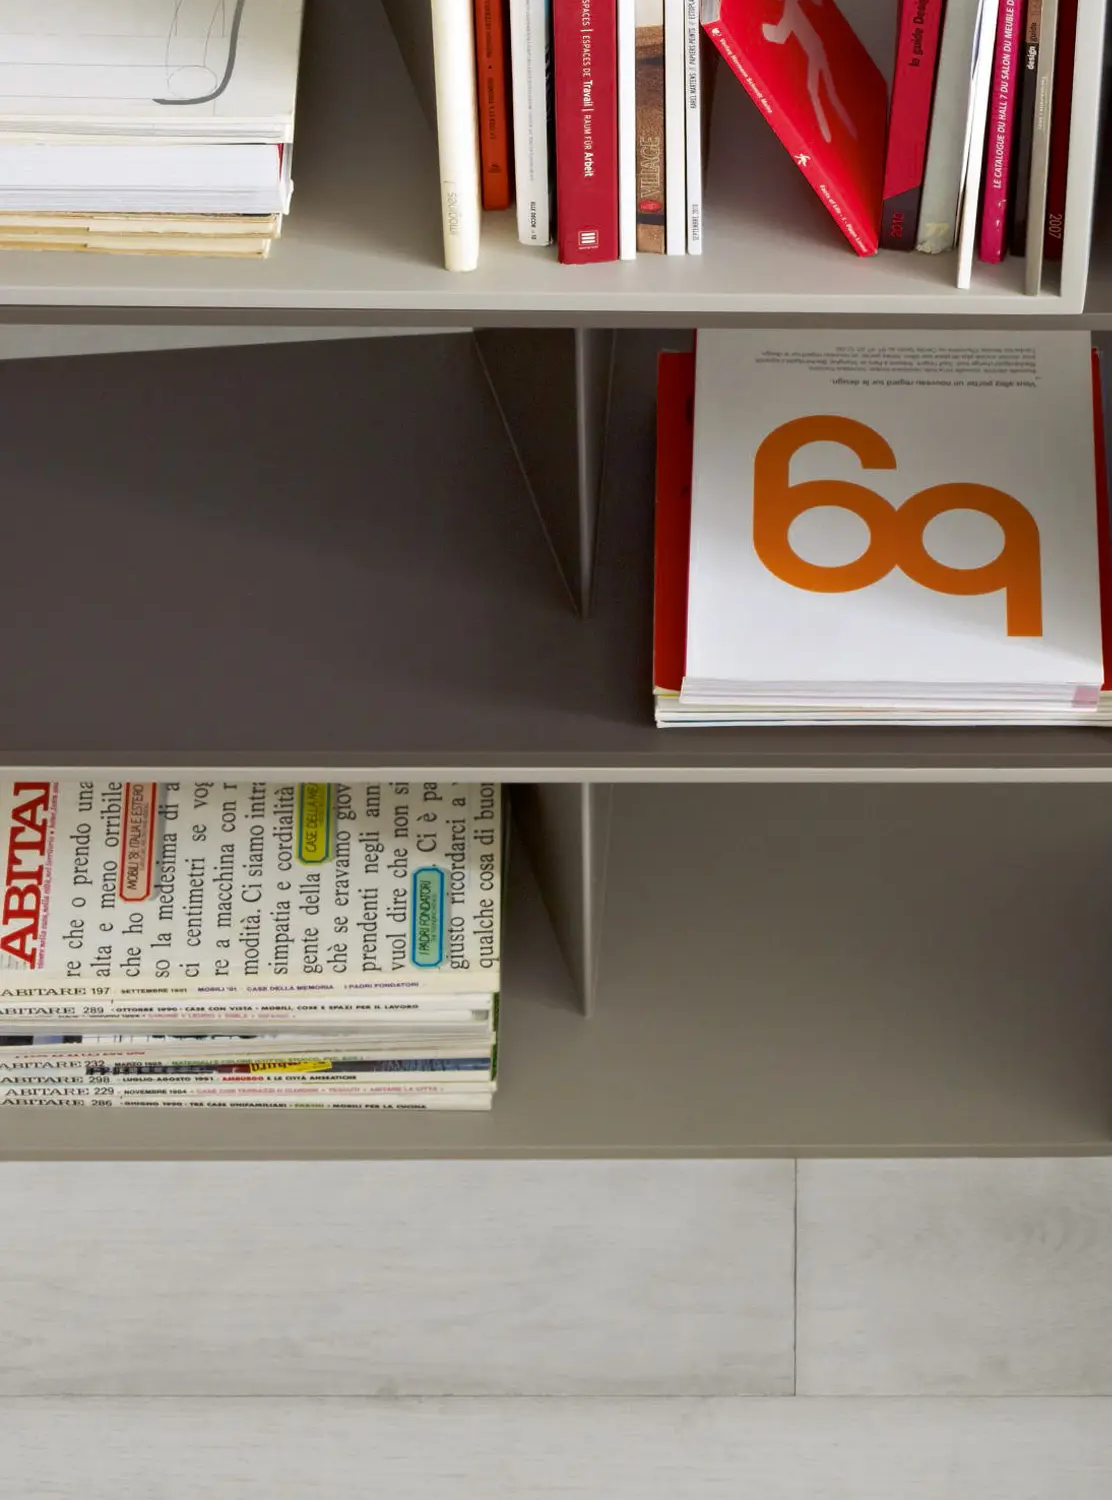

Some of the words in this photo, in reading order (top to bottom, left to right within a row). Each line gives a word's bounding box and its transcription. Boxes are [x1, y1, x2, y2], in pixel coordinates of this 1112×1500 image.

[580, 0, 591, 26] SPACES
[1004, 8, 1015, 40] MEUBLE
[581, 35, 592, 65] ESPACES
[912, 26, 925, 55] guide
[1003, 40, 1012, 54] DU
[582, 66, 592, 77] DE
[1001, 54, 1012, 80] SALON
[1026, 45, 1036, 71] design
[582, 80, 594, 107] Travail
[1000, 80, 1010, 93] DU
[998, 100, 1009, 117] HALL
[583, 114, 593, 135] RAUM
[997, 117, 1007, 131] DU
[584, 136, 594, 151] FÜR
[994, 131, 1006, 179] CATALOGUE
[584, 151, 595, 178] Arbeit
[640, 135, 662, 198] VILLAGE
[993, 179, 1002, 189] LE
[1048, 212, 1064, 240] 2007
[77, 781, 93, 812] una
[130, 784, 144, 817] ESTERO
[450, 797, 466, 807] a
[100, 781, 122, 848] orribile
[157, 804, 179, 821] di
[220, 800, 237, 833] con
[392, 804, 409, 838] non
[416, 813, 437, 822] è
[127, 825, 142, 849] ITALIA
[190, 824, 207, 842] se
[272, 786, 294, 871] cordialità
[473, 829, 494, 846] di
[69, 823, 92, 885] prendo
[241, 825, 265, 877] siamo
[358, 830, 384, 873] negli
[416, 833, 437, 853] Ci
[333, 830, 351, 906] eravamo
[386, 848, 408, 879] che
[444, 817, 466, 905] ricordarci
[479, 853, 494, 891] cosa
[98, 860, 118, 909] meno
[125, 861, 139, 890] MOBILI
[153, 833, 177, 920] medesima
[212, 843, 235, 928] macchina
[276, 881, 291, 891] e
[70, 897, 86, 908] o
[182, 857, 205, 947] centimetri
[240, 884, 262, 903] Ci
[298, 872, 321, 915] della
[385, 888, 408, 922] dire
[419, 880, 431, 926] FONDATORI
[61, 919, 84, 949] che
[98, 922, 114, 932] e
[121, 912, 143, 934] ho
[332, 916, 348, 933] se
[356, 887, 382, 972] prendenti
[472, 898, 500, 969] qualche
[150, 932, 171, 948] la
[214, 939, 230, 948] a
[238, 909, 261, 976] modità.
[267, 900, 295, 975] simpatia
[298, 928, 323, 974] gente
[418, 927, 431, 952] PADRI
[445, 916, 470, 970] giusto
[89, 945, 112, 978] alta
[119, 947, 141, 977] che
[325, 943, 348, 974] chè
[385, 932, 407, 971] vuol
[65, 960, 81, 978] re
[154, 959, 170, 978] so
[178, 963, 200, 978] ci
[213, 959, 229, 977] re
[1, 987, 87, 997] ABITARE
[92, 987, 110, 995] 197
[83, 1006, 104, 1014] 289
[1, 1076, 84, 1084] ABITARE
[88, 1076, 110, 1084] 298
[5, 1088, 89, 1096] ABITARE
[93, 1087, 115, 1095] 229
[91, 1099, 113, 1107] 286
